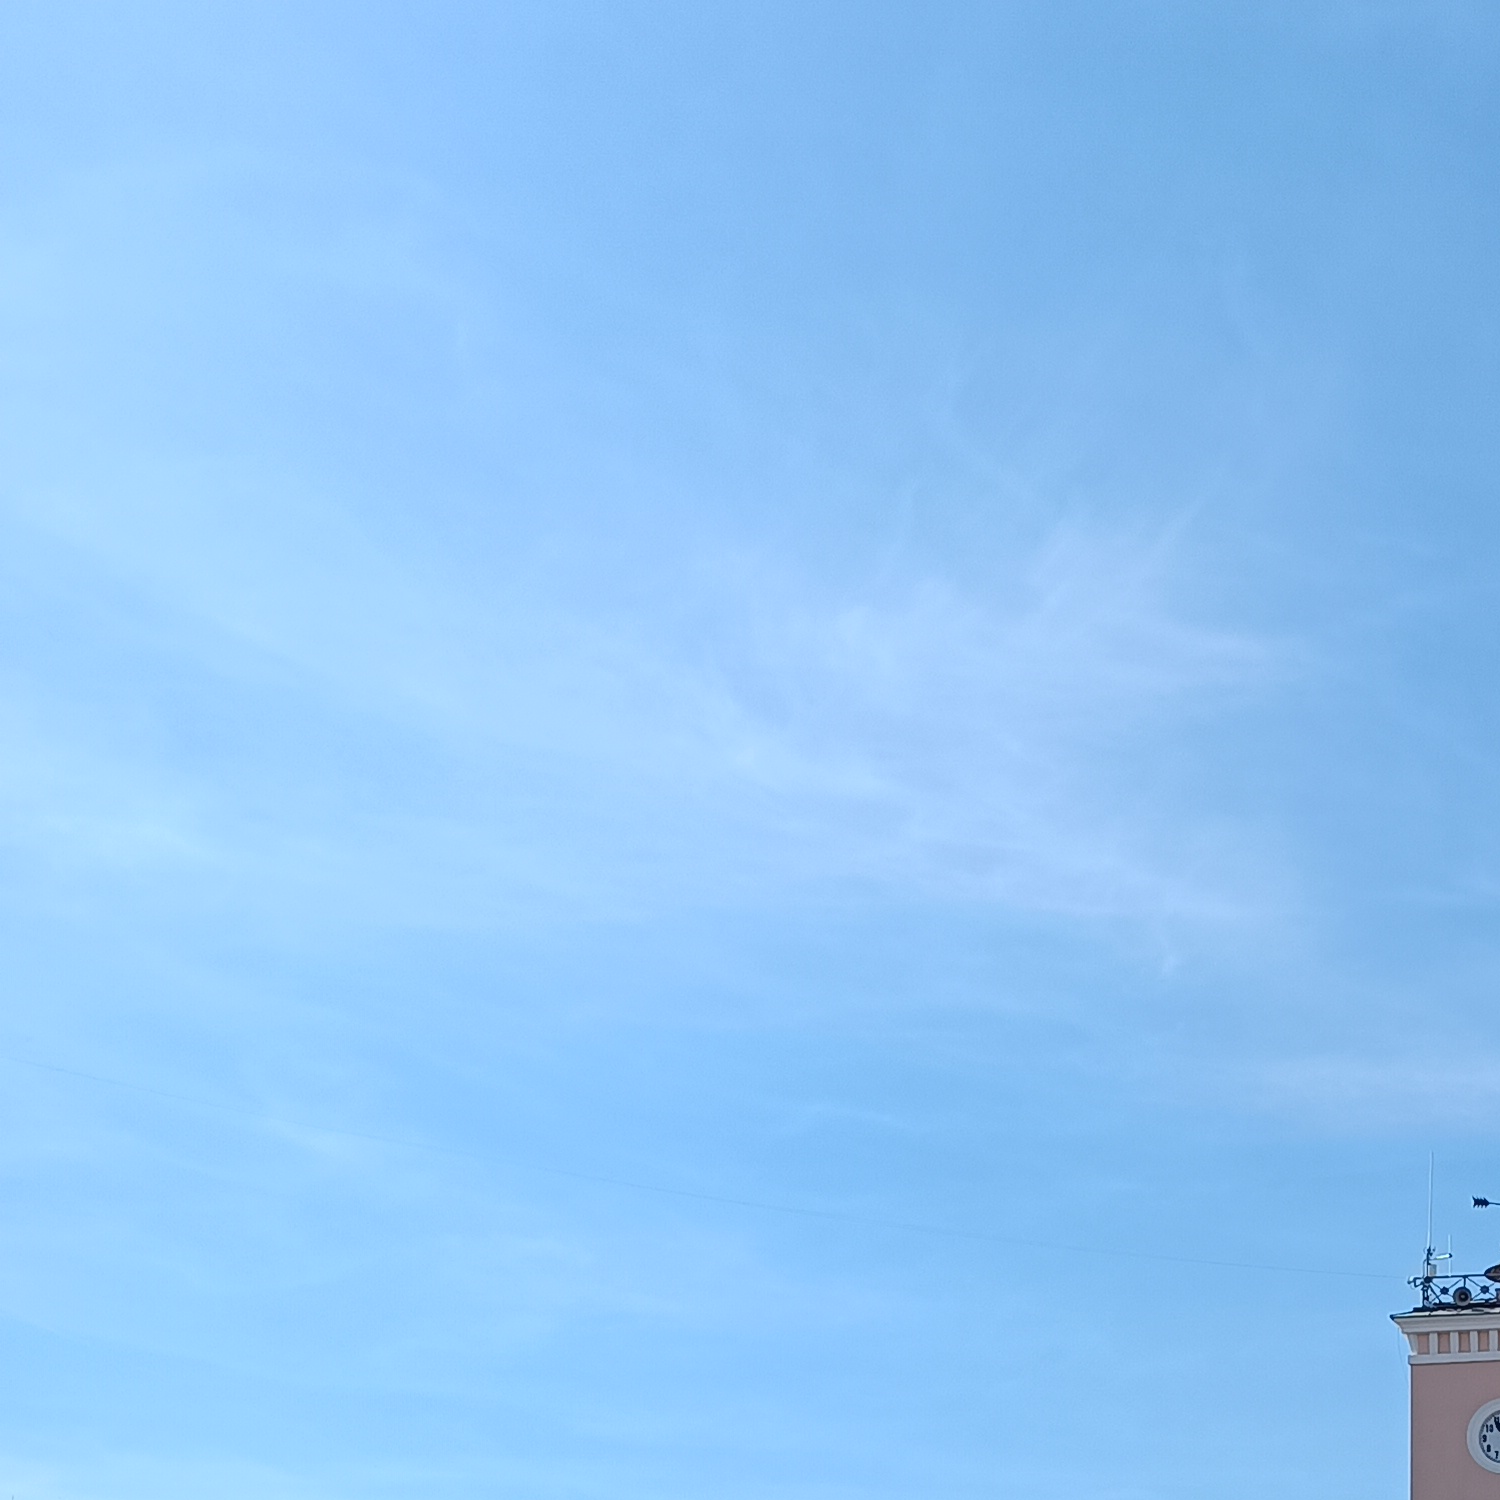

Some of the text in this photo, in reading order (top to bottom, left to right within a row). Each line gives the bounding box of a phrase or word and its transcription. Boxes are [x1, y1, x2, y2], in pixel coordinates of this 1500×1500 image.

[1486, 1424, 1494, 1433] 10
[1482, 1434, 1487, 1443] 9
[1486, 1444, 1491, 1453] 8
[1495, 1450, 1499, 1459] 7
